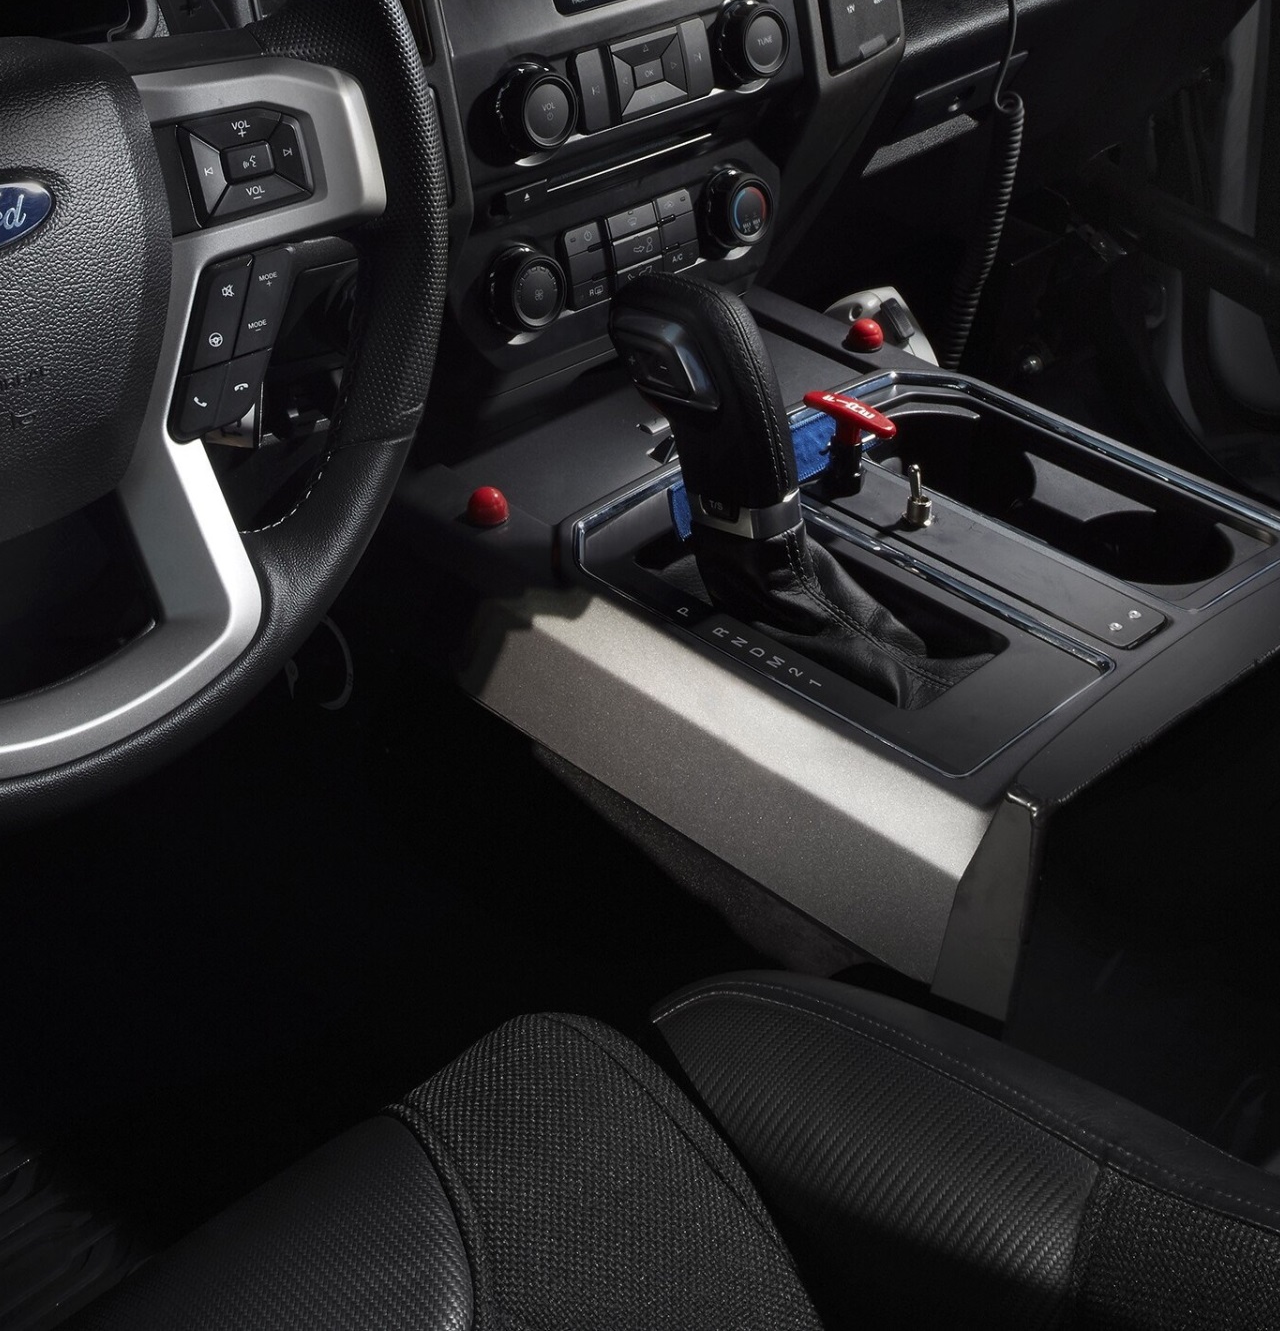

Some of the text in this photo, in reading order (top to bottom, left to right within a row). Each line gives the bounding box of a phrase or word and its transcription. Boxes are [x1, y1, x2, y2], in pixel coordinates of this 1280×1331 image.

[757, 35, 773, 47] TUNE
[644, 69, 654, 78] OK
[541, 101, 555, 112] VOL
[231, 120, 250, 131] VOL
[245, 185, 265, 196] VOL
[672, 253, 683, 263] A/C
[258, 271, 278, 281] MODE
[247, 319, 267, 329] MODE
[677, 606, 822, 687] P R N D M 2 1
